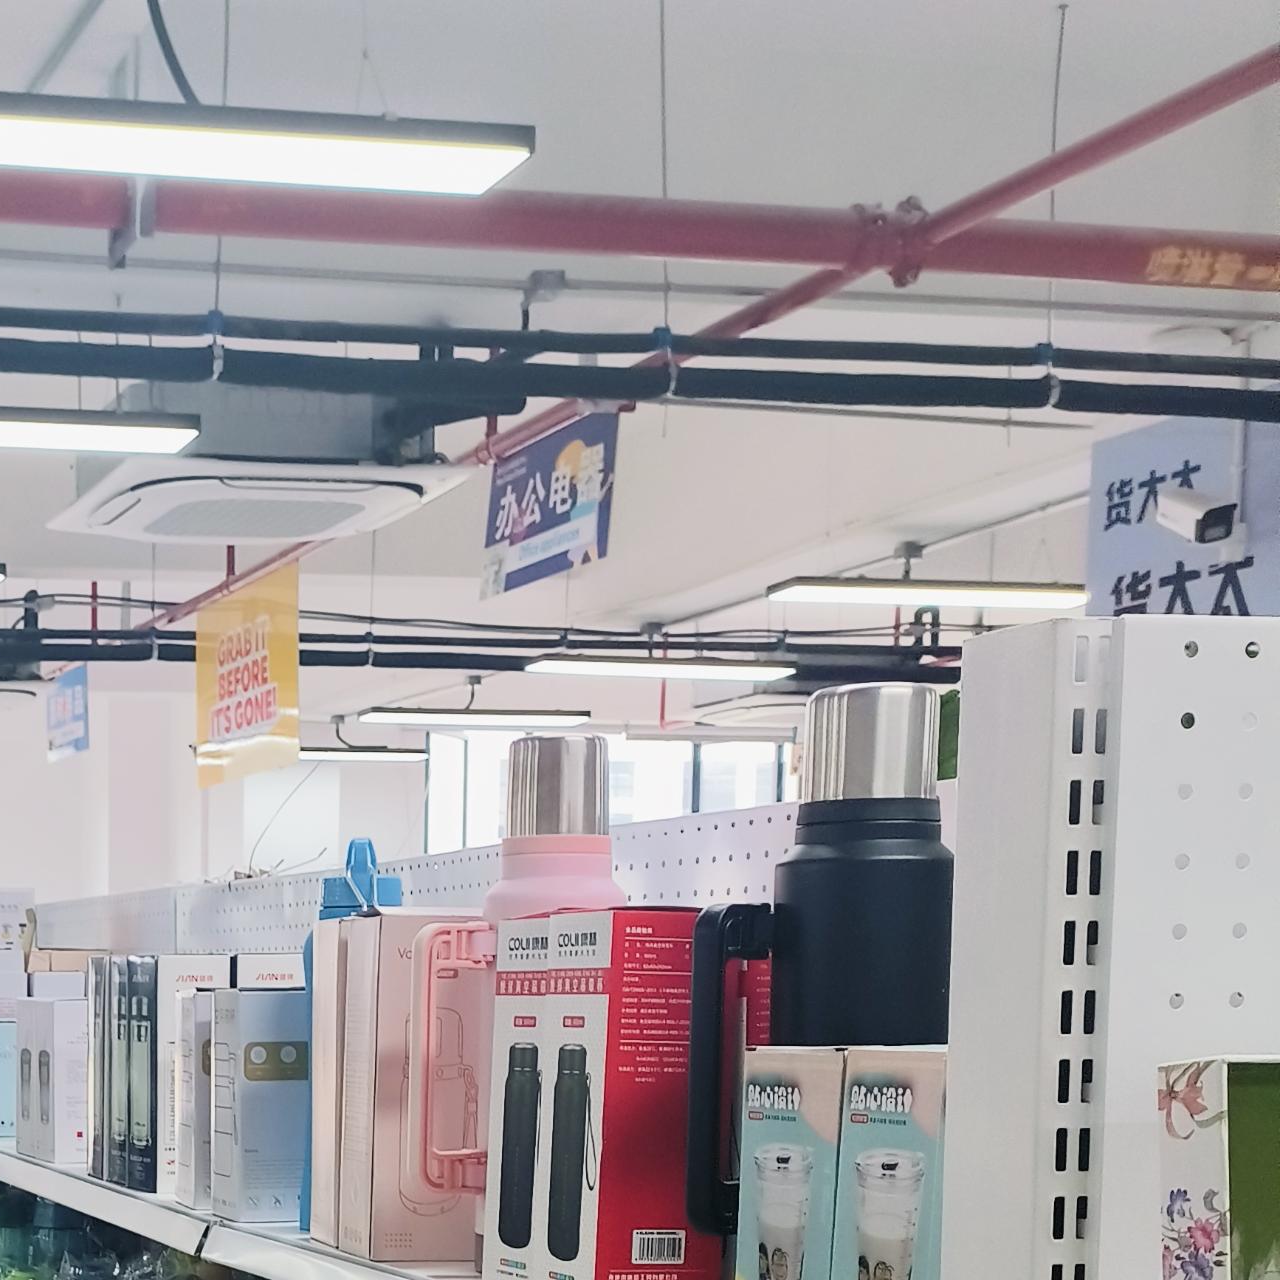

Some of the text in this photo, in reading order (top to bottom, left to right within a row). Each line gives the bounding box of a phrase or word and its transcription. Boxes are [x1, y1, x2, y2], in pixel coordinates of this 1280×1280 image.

[217, 628, 267, 667] GRAB IT
[218, 655, 269, 699] BEFORE
[211, 686, 277, 738] IT'S GONE!
[748, 1084, 801, 1111] 贴心设计
[850, 1084, 913, 1113] 贴心设计
